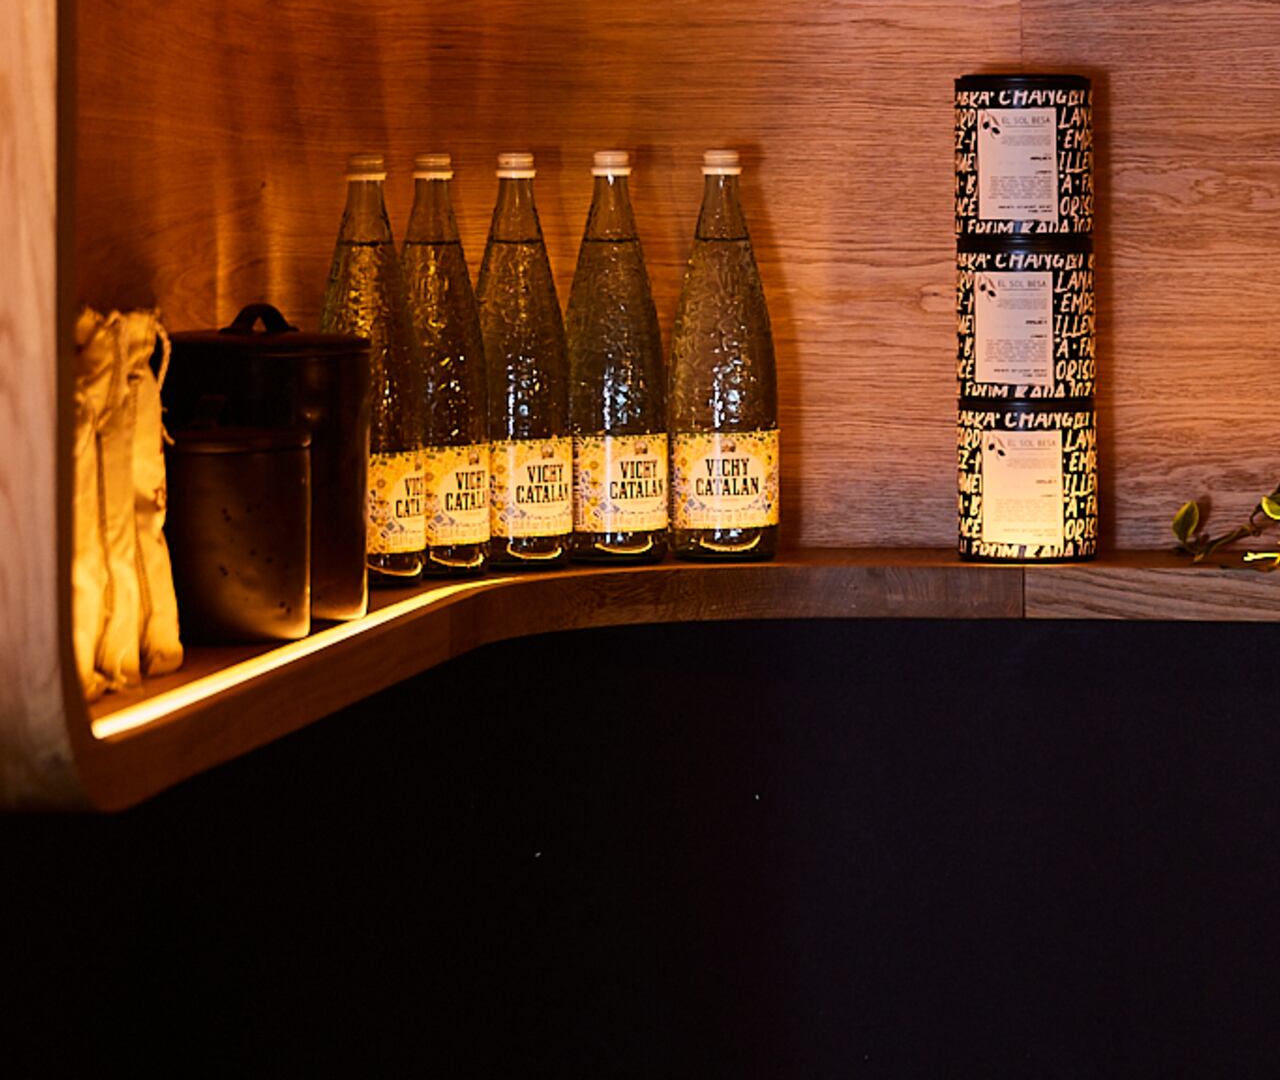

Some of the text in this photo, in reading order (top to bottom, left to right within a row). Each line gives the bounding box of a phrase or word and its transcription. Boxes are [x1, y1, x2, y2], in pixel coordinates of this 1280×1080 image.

[526, 464, 564, 483] VICHY
[619, 460, 658, 479] VICHY
[705, 458, 750, 477] VICHY
[609, 479, 664, 500] CATALAN
[695, 477, 760, 496] CATALAN
